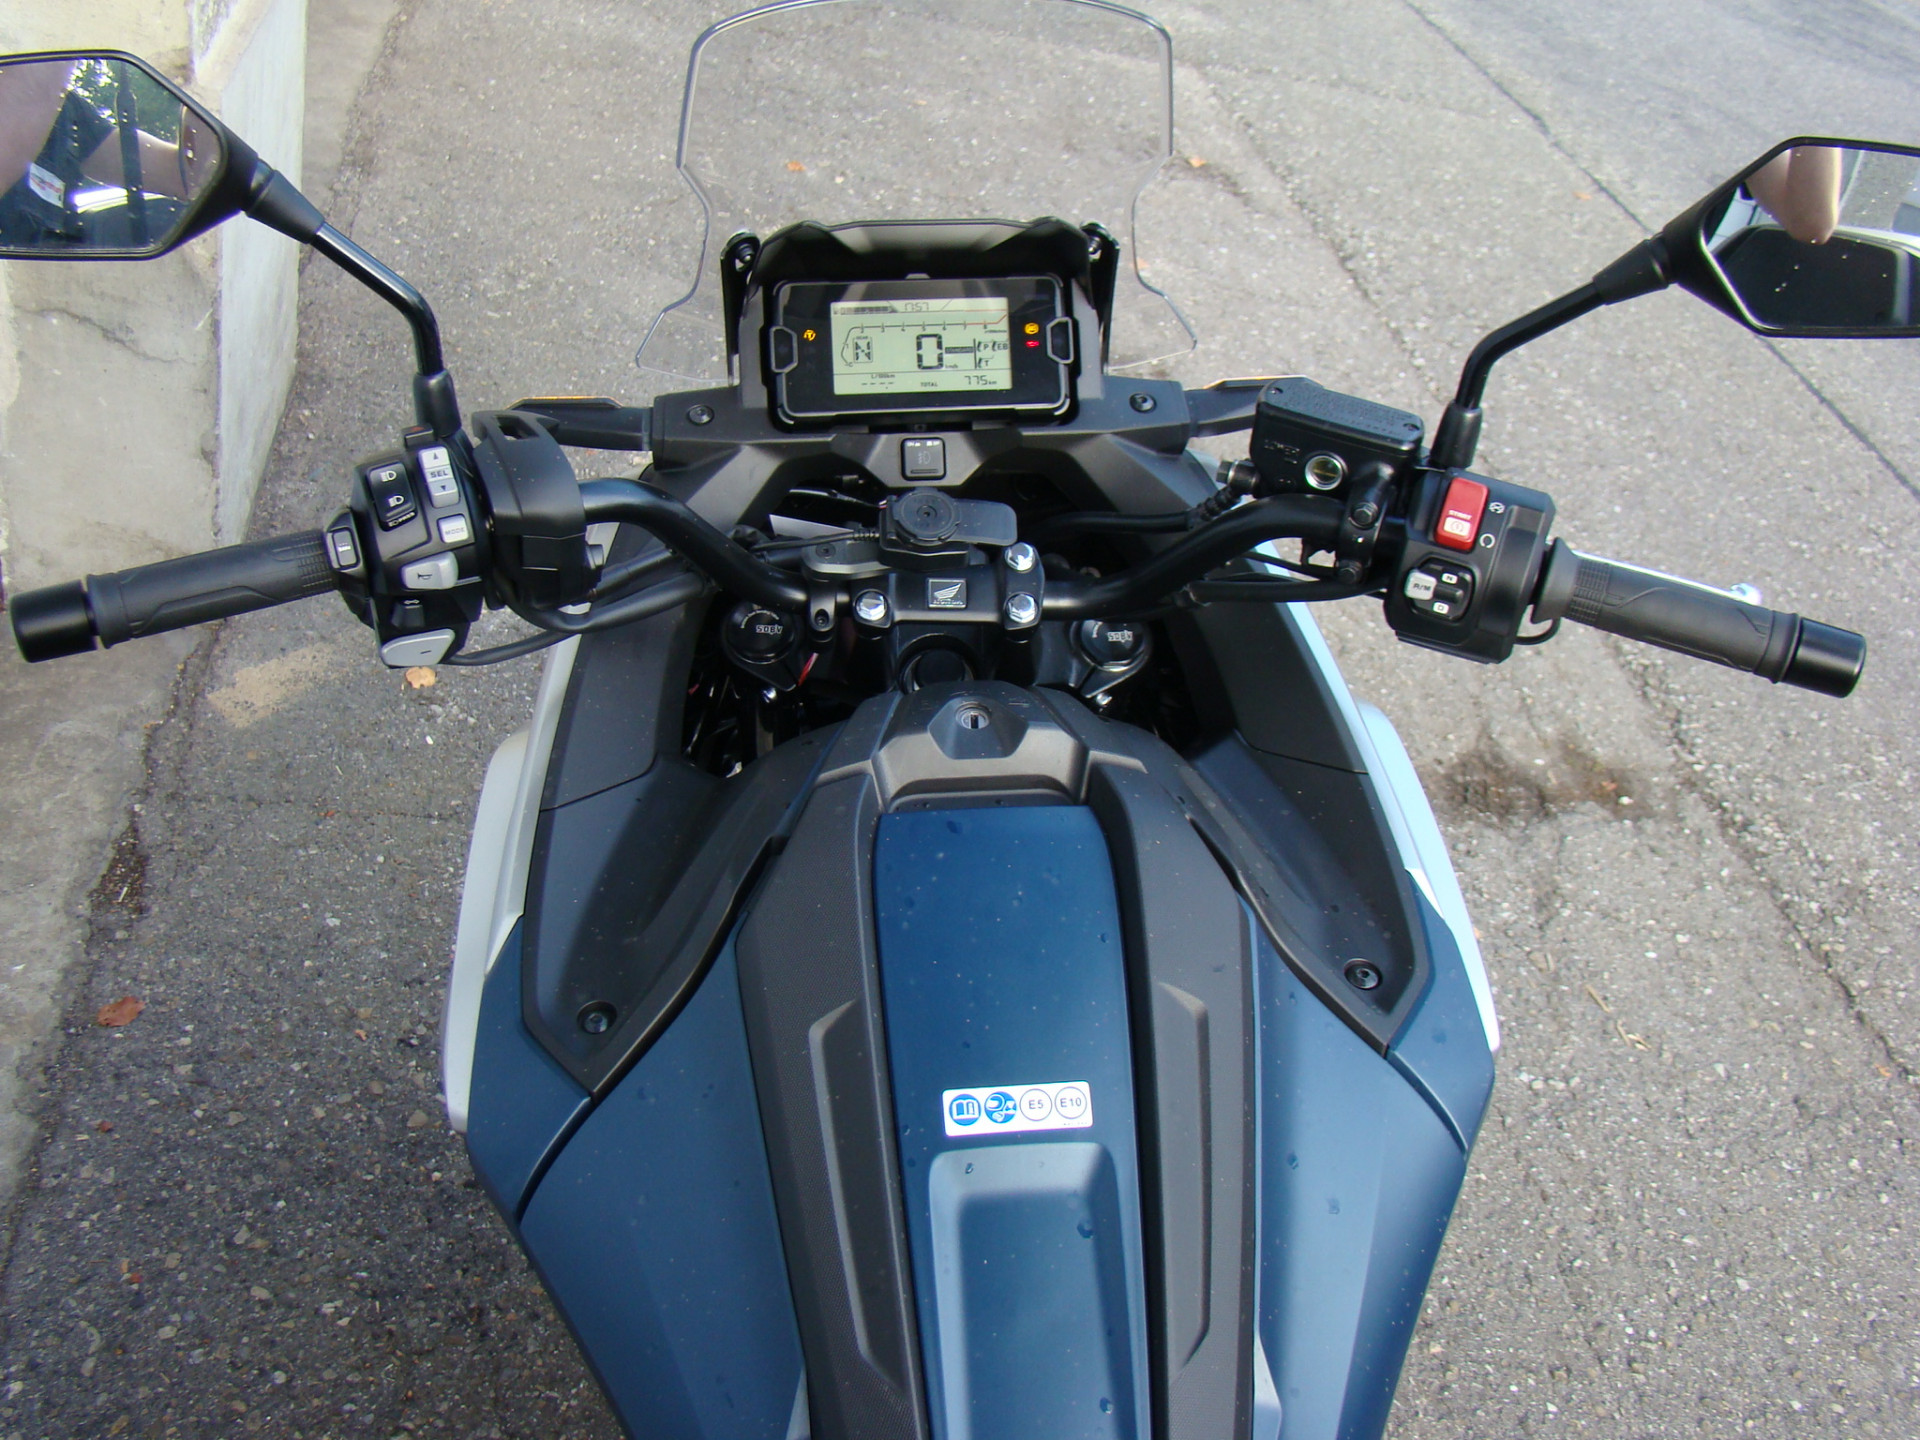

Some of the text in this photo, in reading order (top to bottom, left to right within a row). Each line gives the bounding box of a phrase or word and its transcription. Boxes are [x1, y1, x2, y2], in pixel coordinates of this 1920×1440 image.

[855, 341, 871, 361] N
[915, 333, 944, 370] 0
[964, 375, 988, 385] 775
[430, 470, 449, 478] SEL
[445, 527, 465, 535] MODE
[1028, 1097, 1082, 1110] E5 E10
